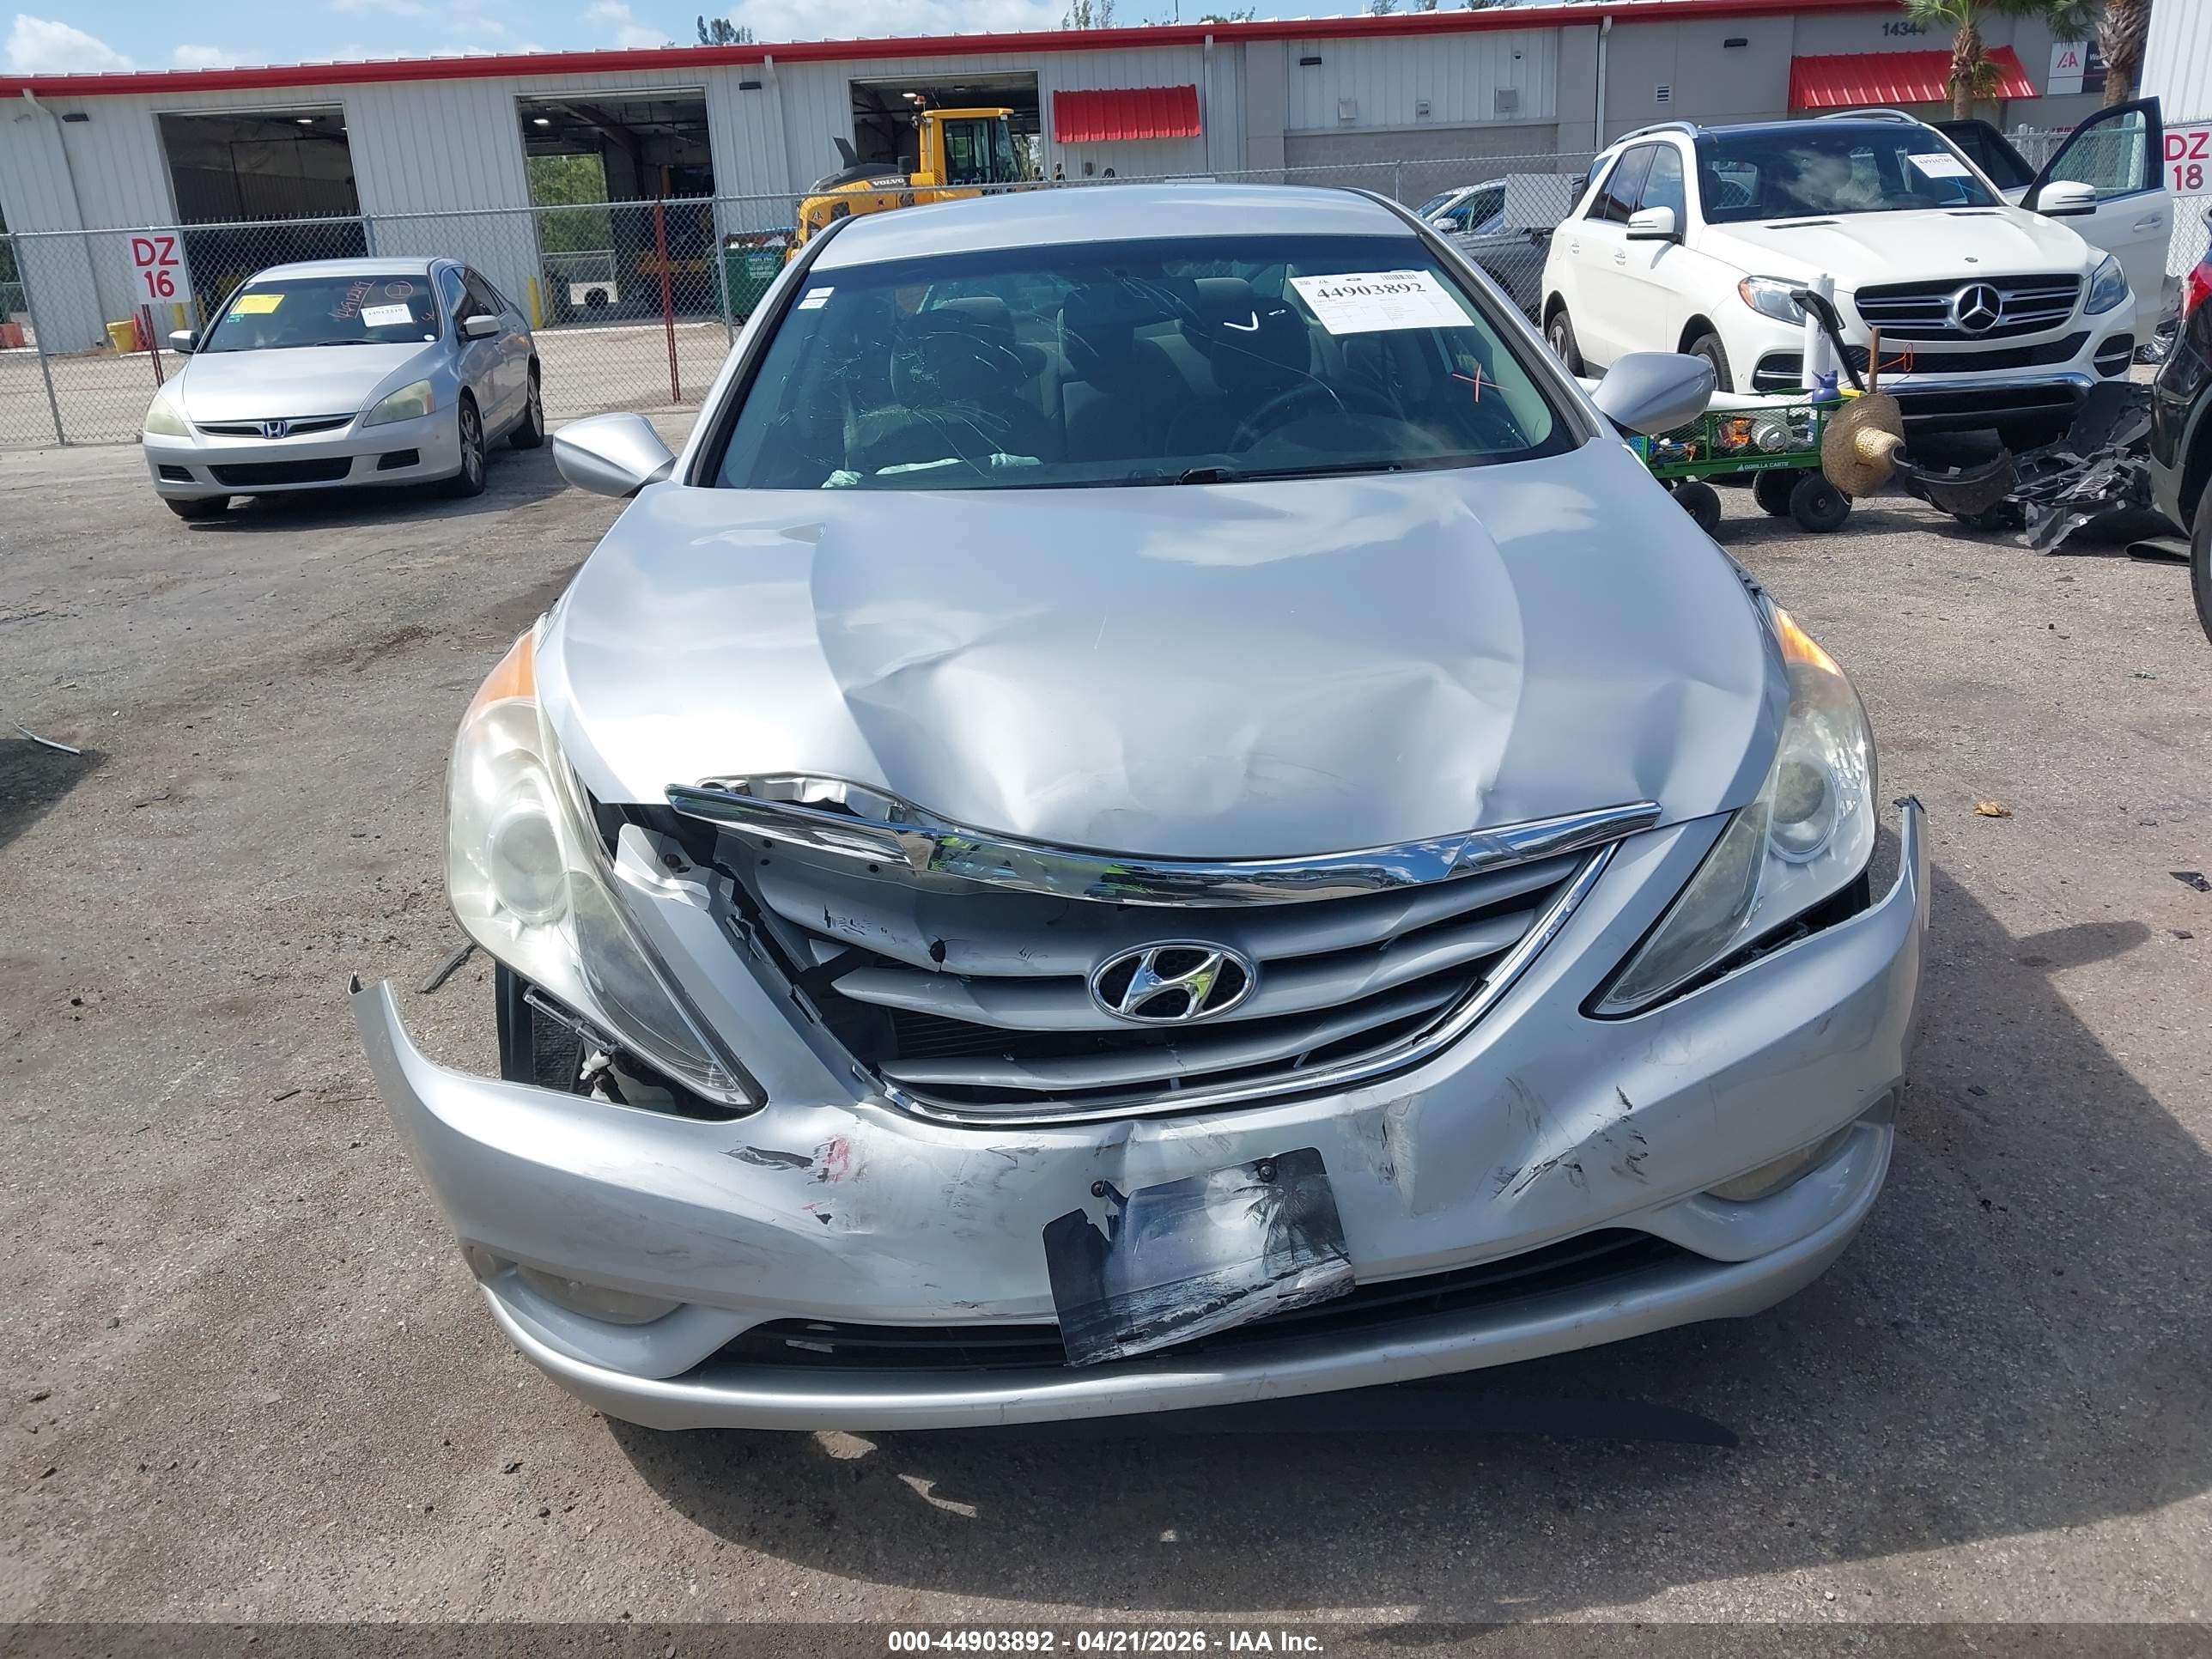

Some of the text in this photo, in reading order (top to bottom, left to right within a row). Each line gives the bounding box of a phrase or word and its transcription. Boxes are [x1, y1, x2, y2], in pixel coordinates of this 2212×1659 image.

[2165, 132, 2209, 161] DZ
[872, 178, 904, 186] VOLVO
[2173, 163, 2203, 191] 18
[131, 237, 179, 266] DZ
[144, 270, 174, 298] 16
[1317, 283, 1426, 299] 44903892
